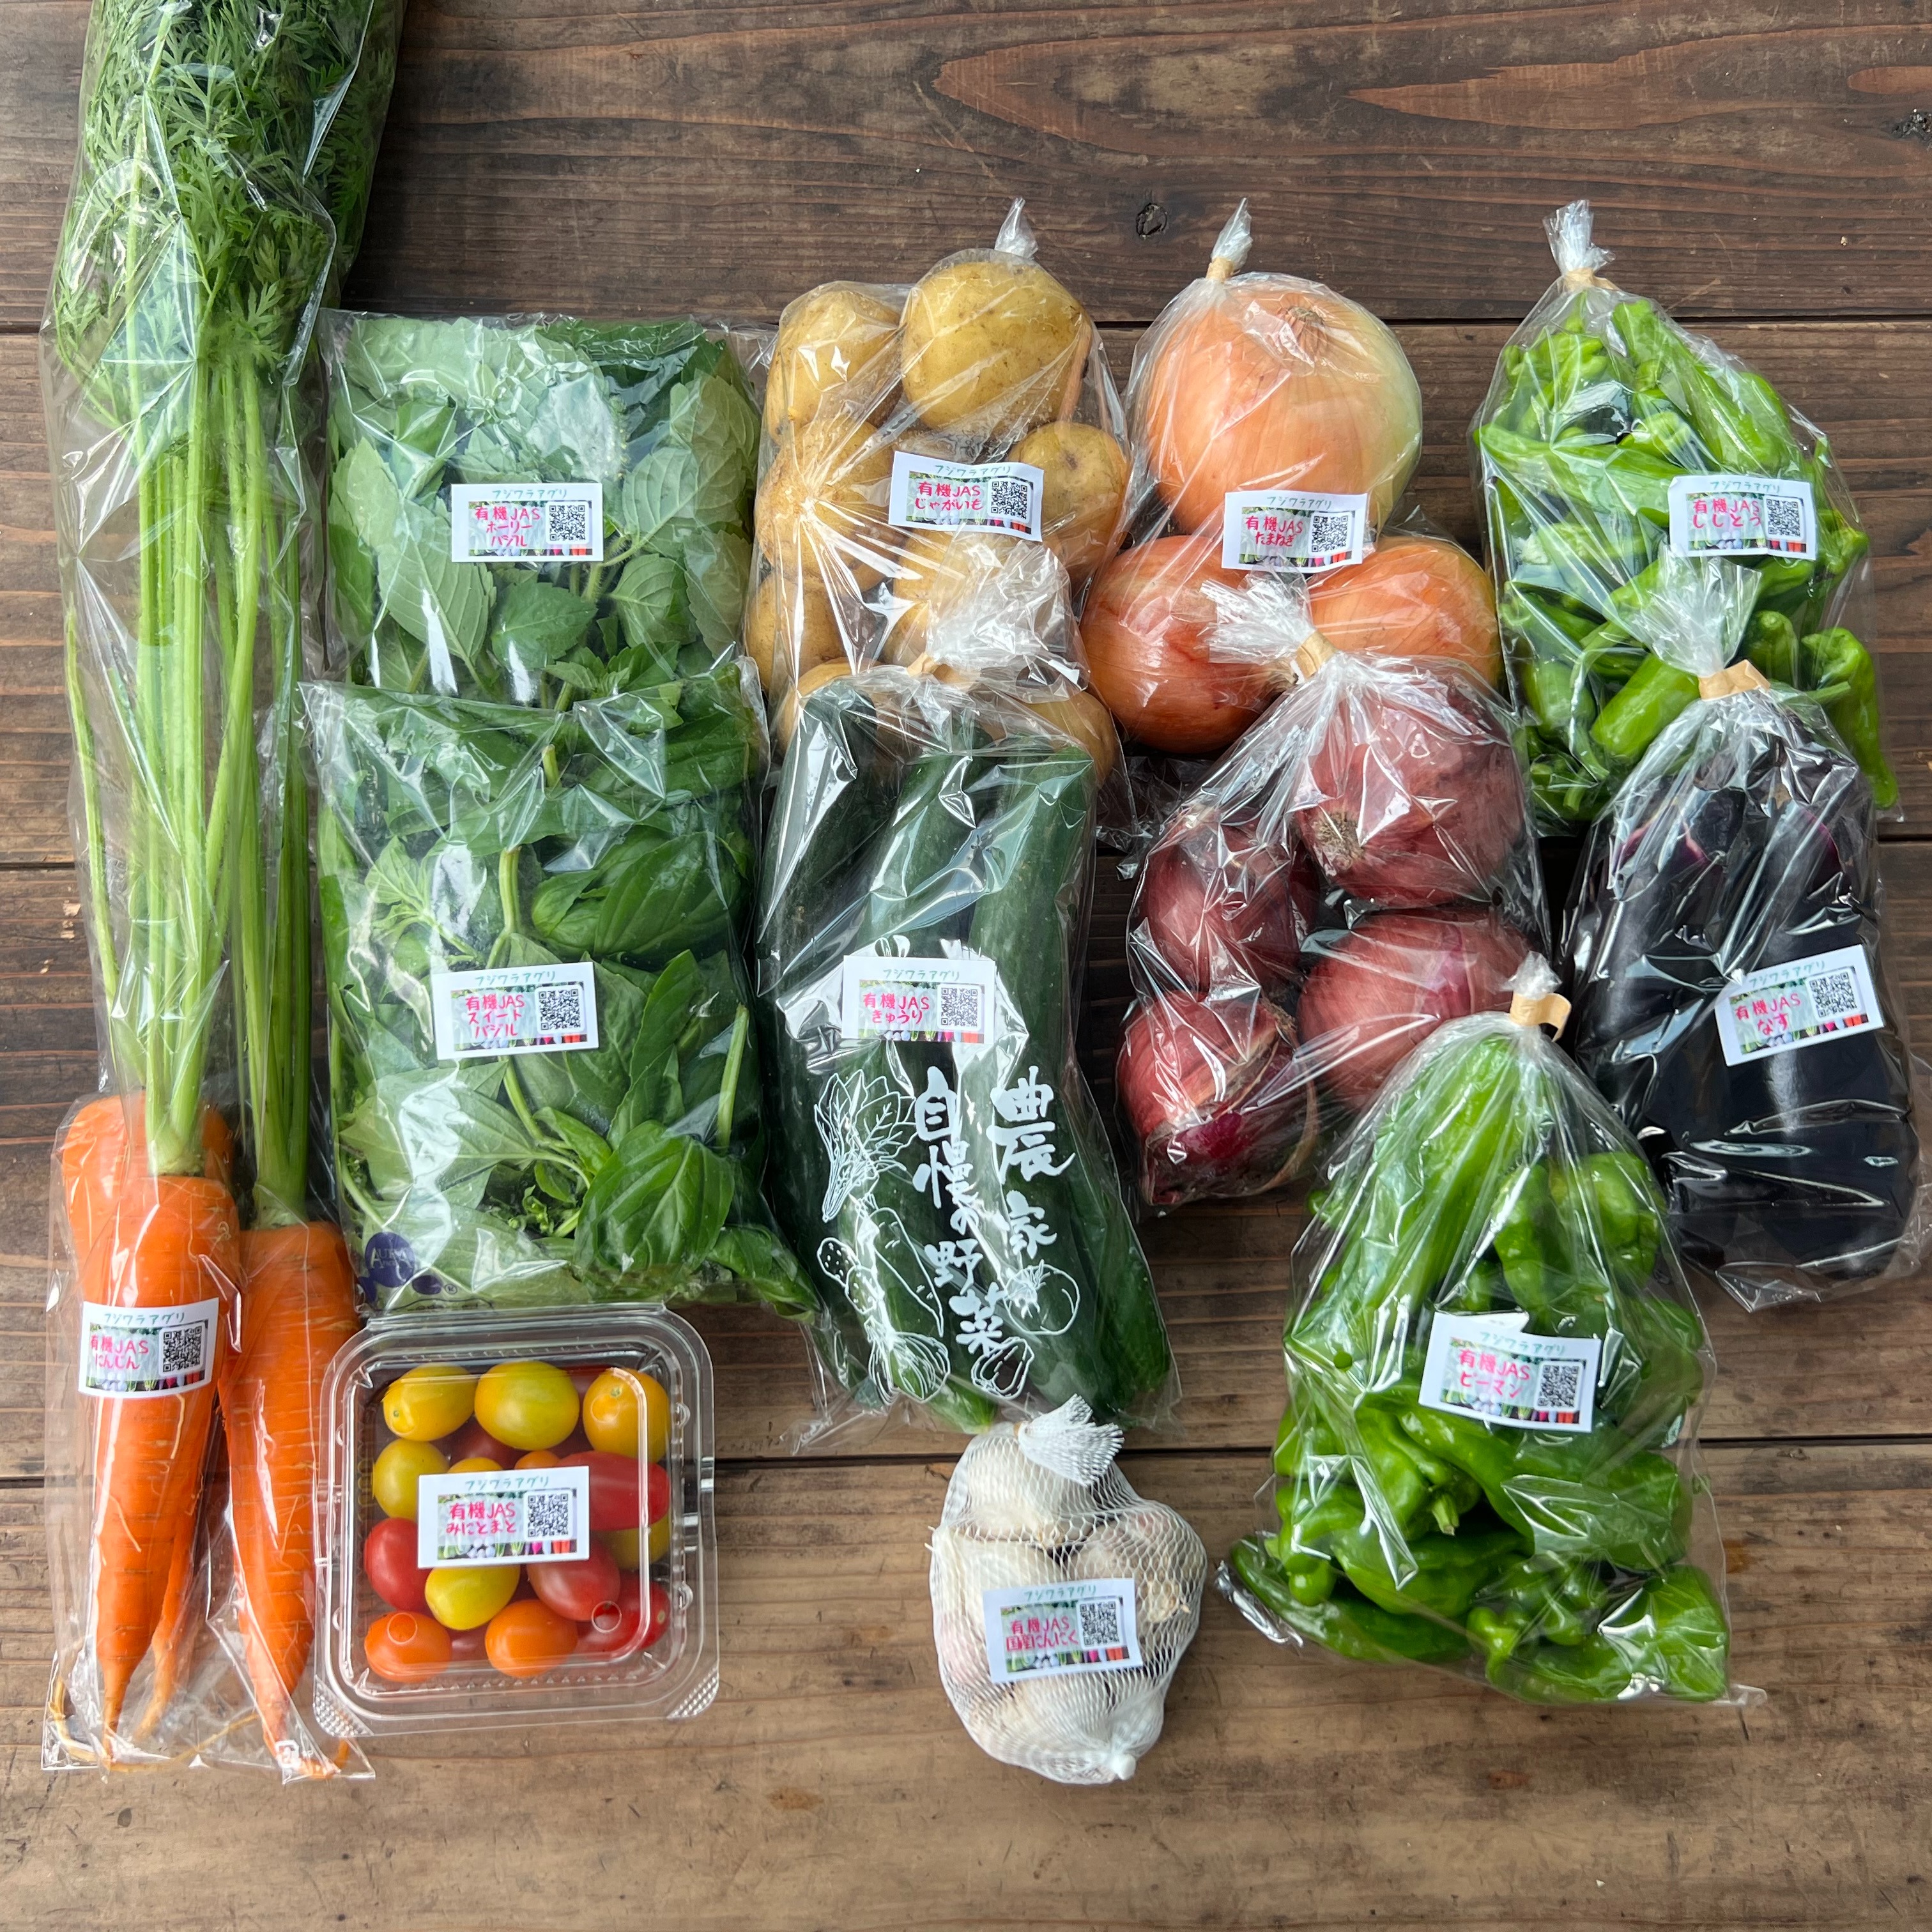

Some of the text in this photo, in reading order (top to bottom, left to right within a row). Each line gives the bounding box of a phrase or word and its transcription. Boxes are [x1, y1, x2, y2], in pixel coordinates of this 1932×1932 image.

[935, 464, 1011, 477] フジワラアグリ
[492, 489, 568, 500] フジワラアグリ
[918, 481, 981, 498] 有機JAS
[1710, 480, 1781, 493] フジワラアグリ
[914, 498, 984, 511] じゃがいも
[1267, 496, 1332, 510] フジワラアグリ
[1693, 498, 1760, 514] 有機JAS
[475, 506, 541, 521] 有機JAS
[1692, 512, 1762, 529] ししとう
[486, 521, 533, 533] ホーリー
[1245, 516, 1303, 534] 有機JAS
[491, 535, 528, 547] バジル
[1255, 532, 1294, 548] たまねぎ
[475, 970, 556, 986] フジワラアグリ
[883, 969, 960, 981] フジワラアグリ
[1749, 960, 1825, 988] フジワラアグリ
[465, 993, 525, 1011] 有機JAS
[862, 992, 930, 1010] 有機JAS
[1734, 992, 1802, 1021] 有機JAS
[468, 1009, 522, 1025] スイート
[871, 1009, 923, 1024] きゅうり
[1757, 1012, 1789, 1036] なす
[475, 1023, 518, 1039] バジル
[986, 1065, 1076, 1259] 農家
[912, 1066, 1006, 1357] 自慢の野菜
[103, 1312, 185, 1326] フジワラアグリ
[90, 1335, 150, 1354] 有機JAS
[1480, 1331, 1566, 1356] フジワラアグリ
[1459, 1348, 1531, 1381] 有機JAS
[1460, 1370, 1524, 1399] ピーマン
[465, 1476, 549, 1491] フジワラアグリ
[449, 1500, 516, 1520] 有機JAS
[445, 1519, 517, 1535] みにとまと
[1023, 1584, 1096, 1601] フジワラアグリ
[1010, 1616, 1070, 1635] 有機JAS
